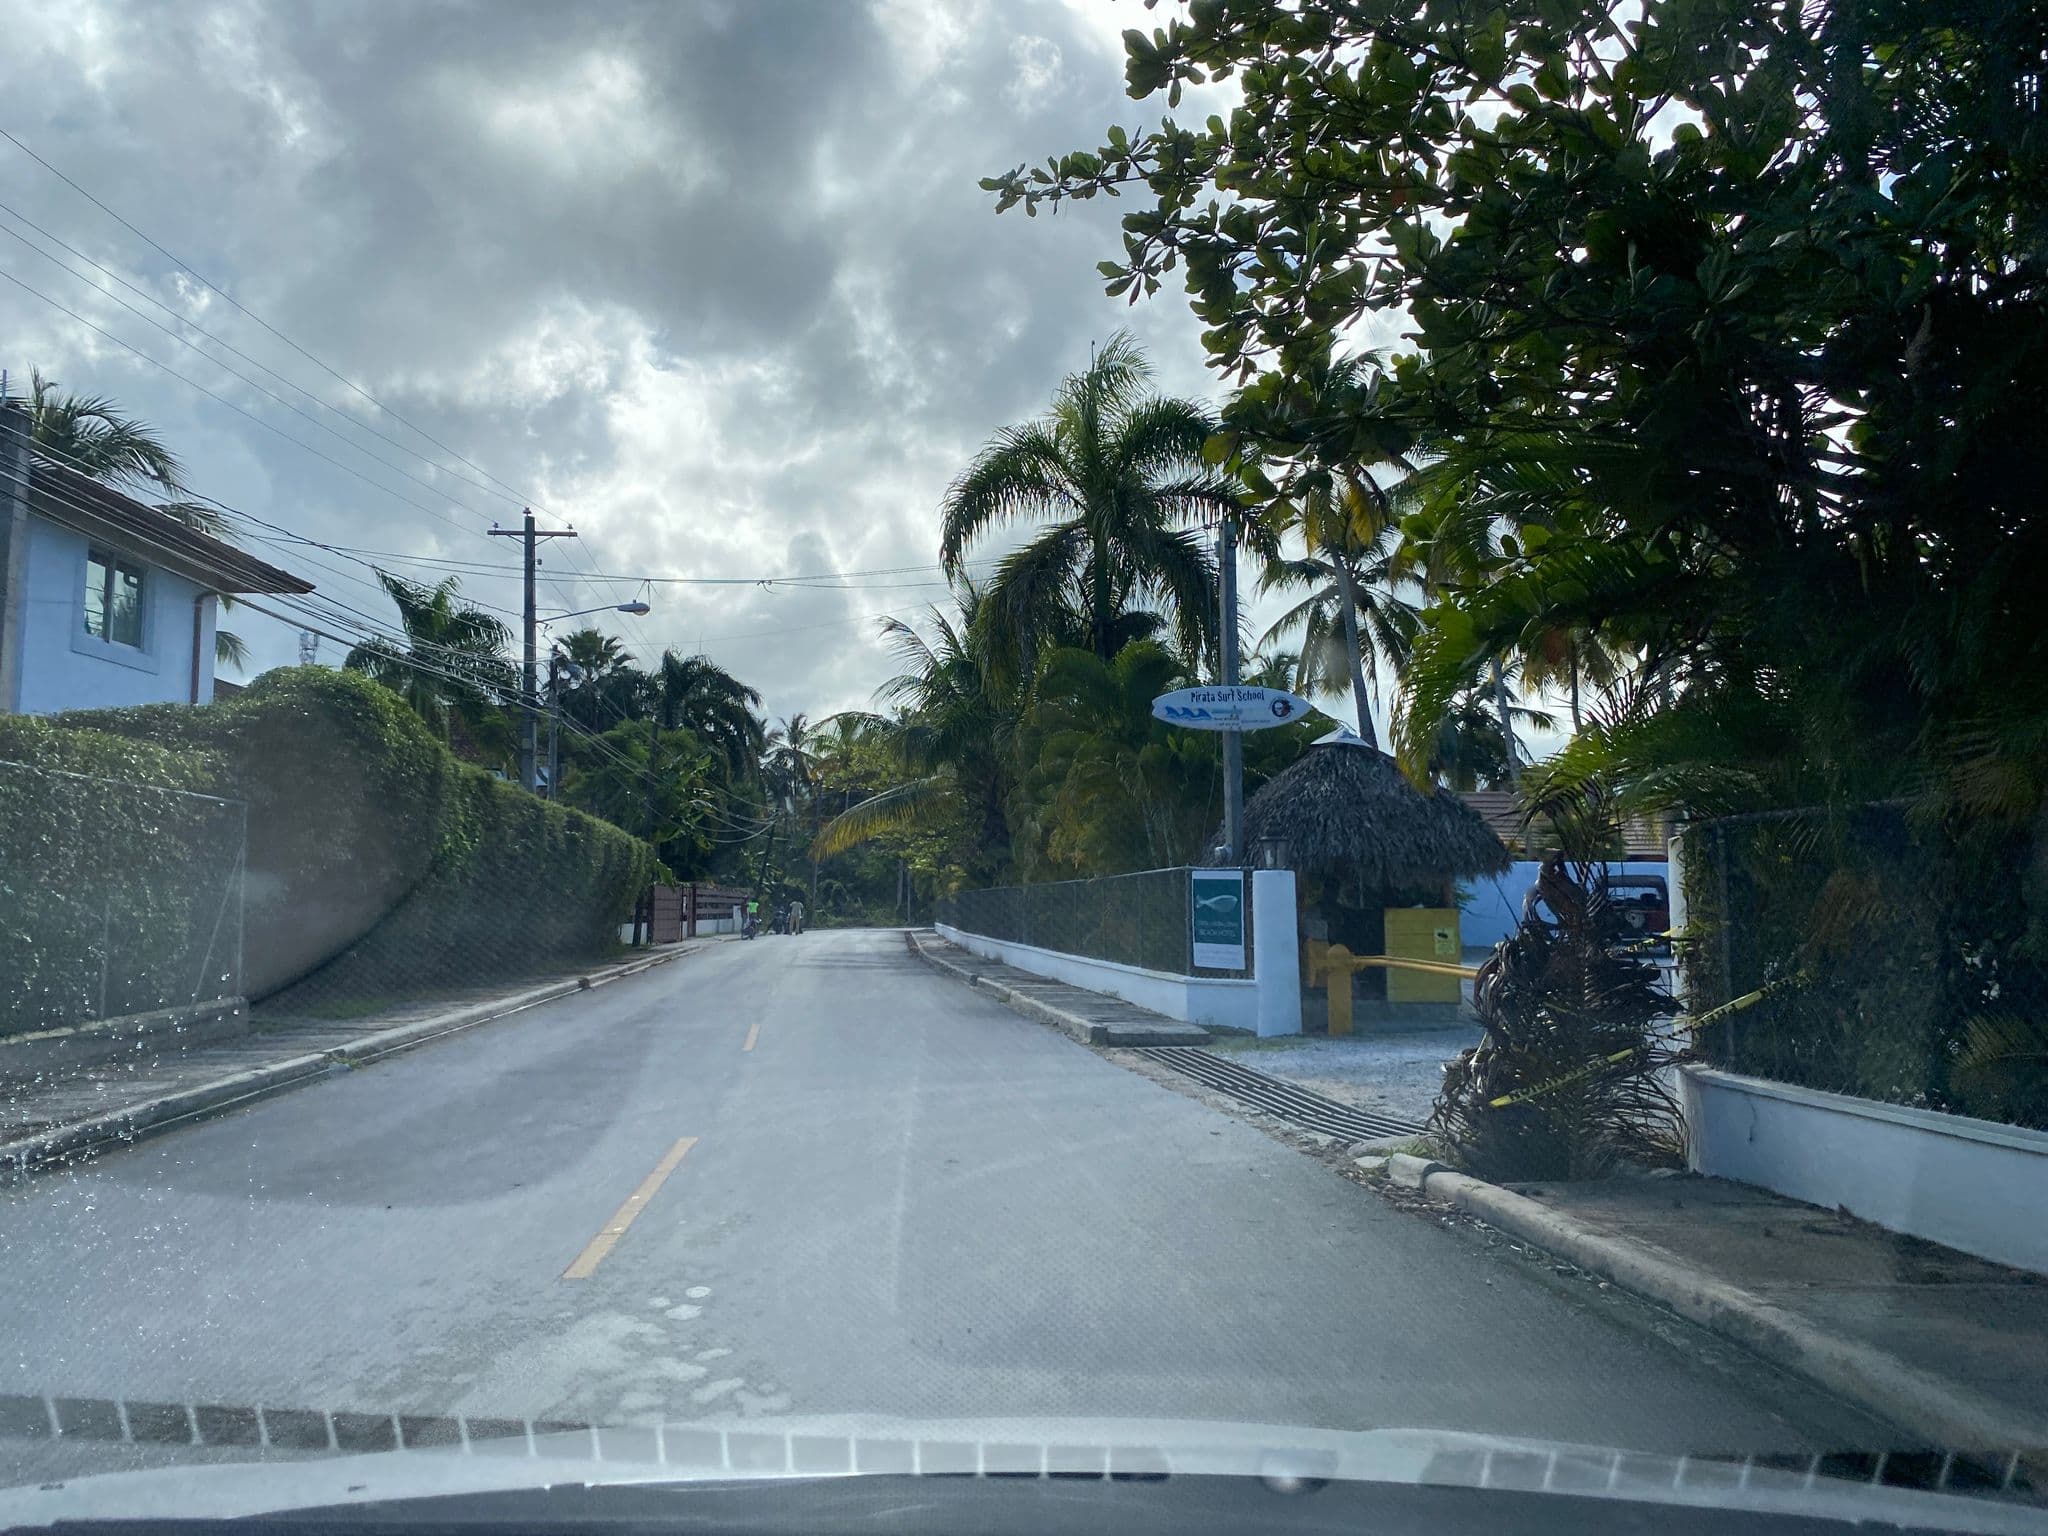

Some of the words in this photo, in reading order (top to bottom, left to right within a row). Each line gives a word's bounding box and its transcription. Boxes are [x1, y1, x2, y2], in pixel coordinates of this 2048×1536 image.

[1191, 691, 1215, 702] Pirata
[1217, 690, 1234, 702] Surf
[1237, 690, 1264, 701] School
